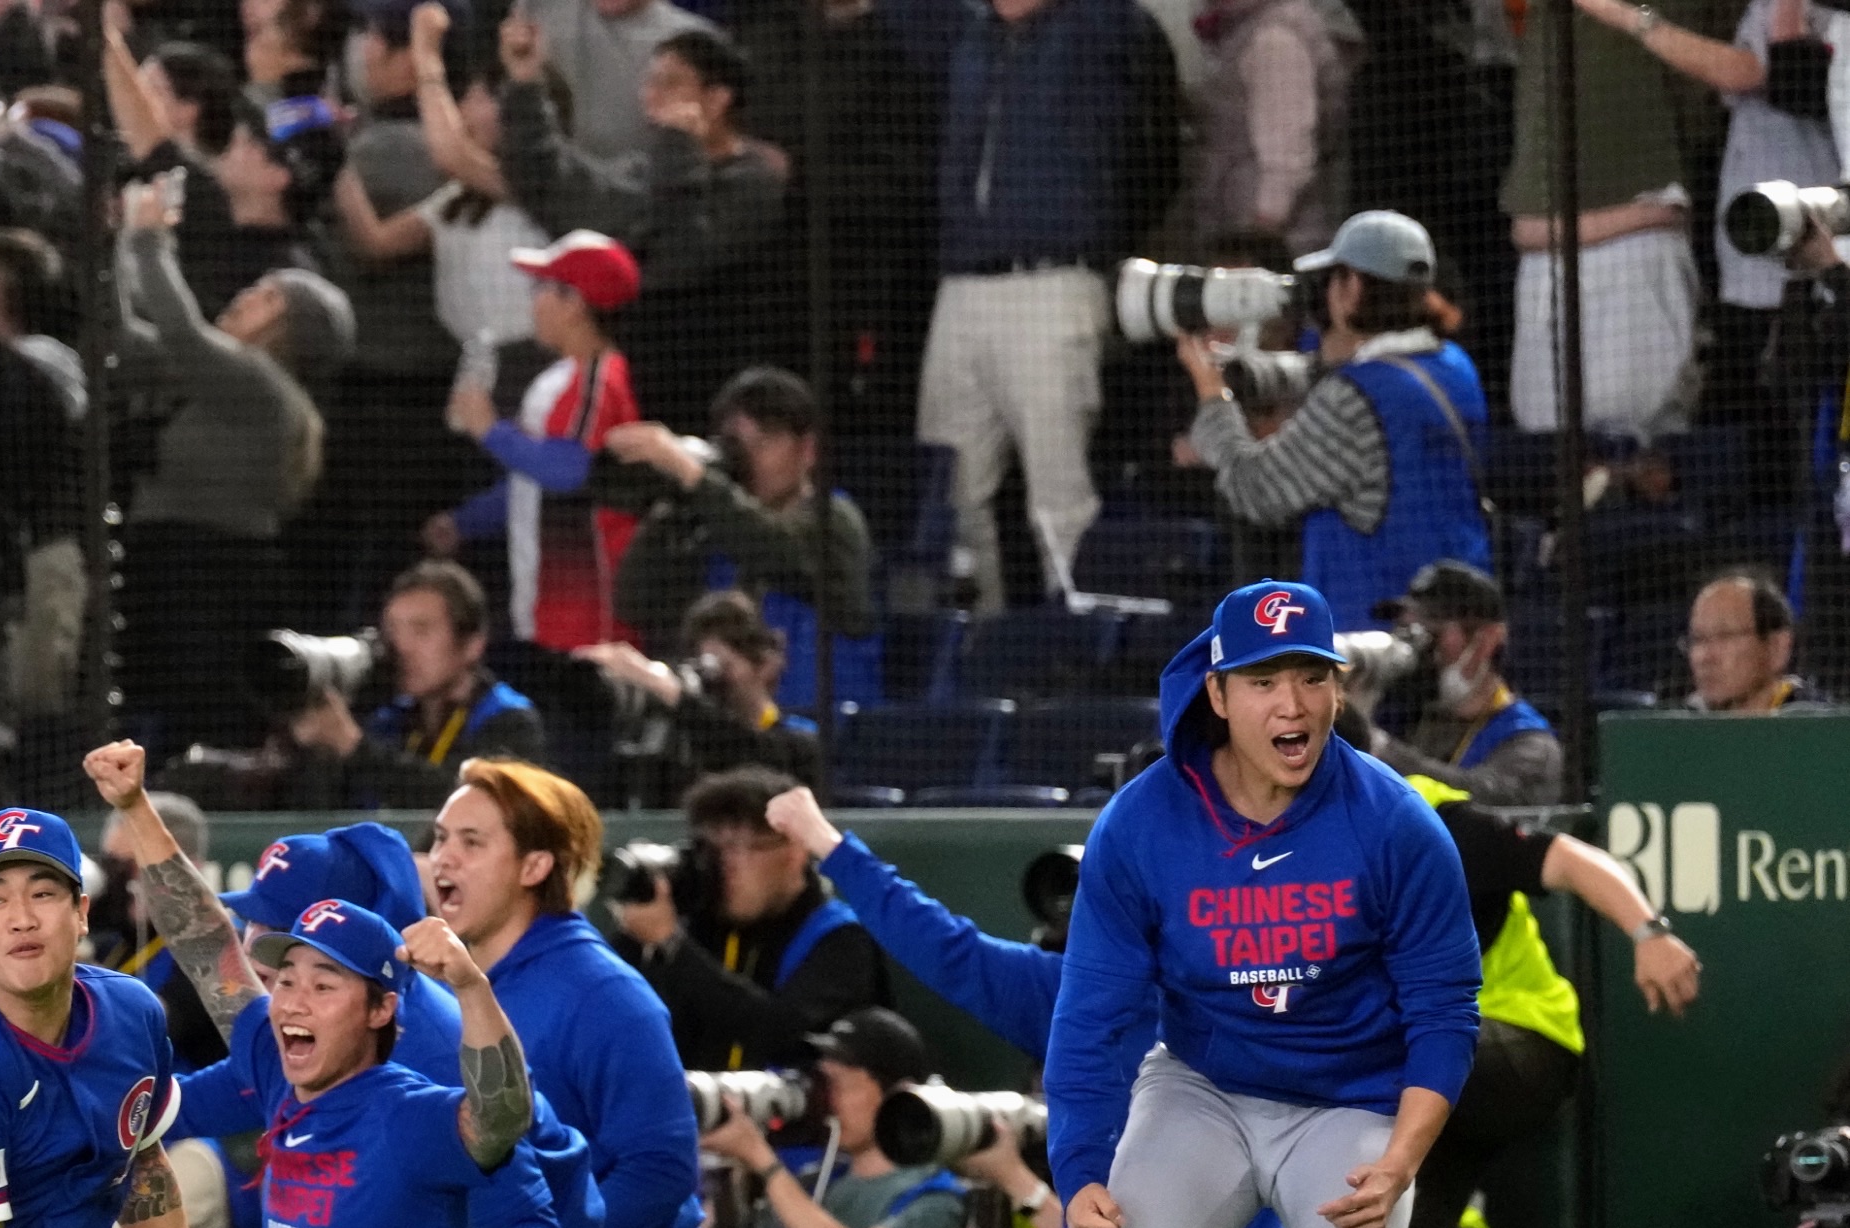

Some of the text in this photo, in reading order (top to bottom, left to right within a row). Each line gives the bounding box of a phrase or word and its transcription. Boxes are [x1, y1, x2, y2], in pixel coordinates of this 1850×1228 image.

[1188, 879, 1357, 927] CHINESE
[1210, 923, 1337, 967] TAIPEI
[1229, 967, 1304, 985] BASEBALL
